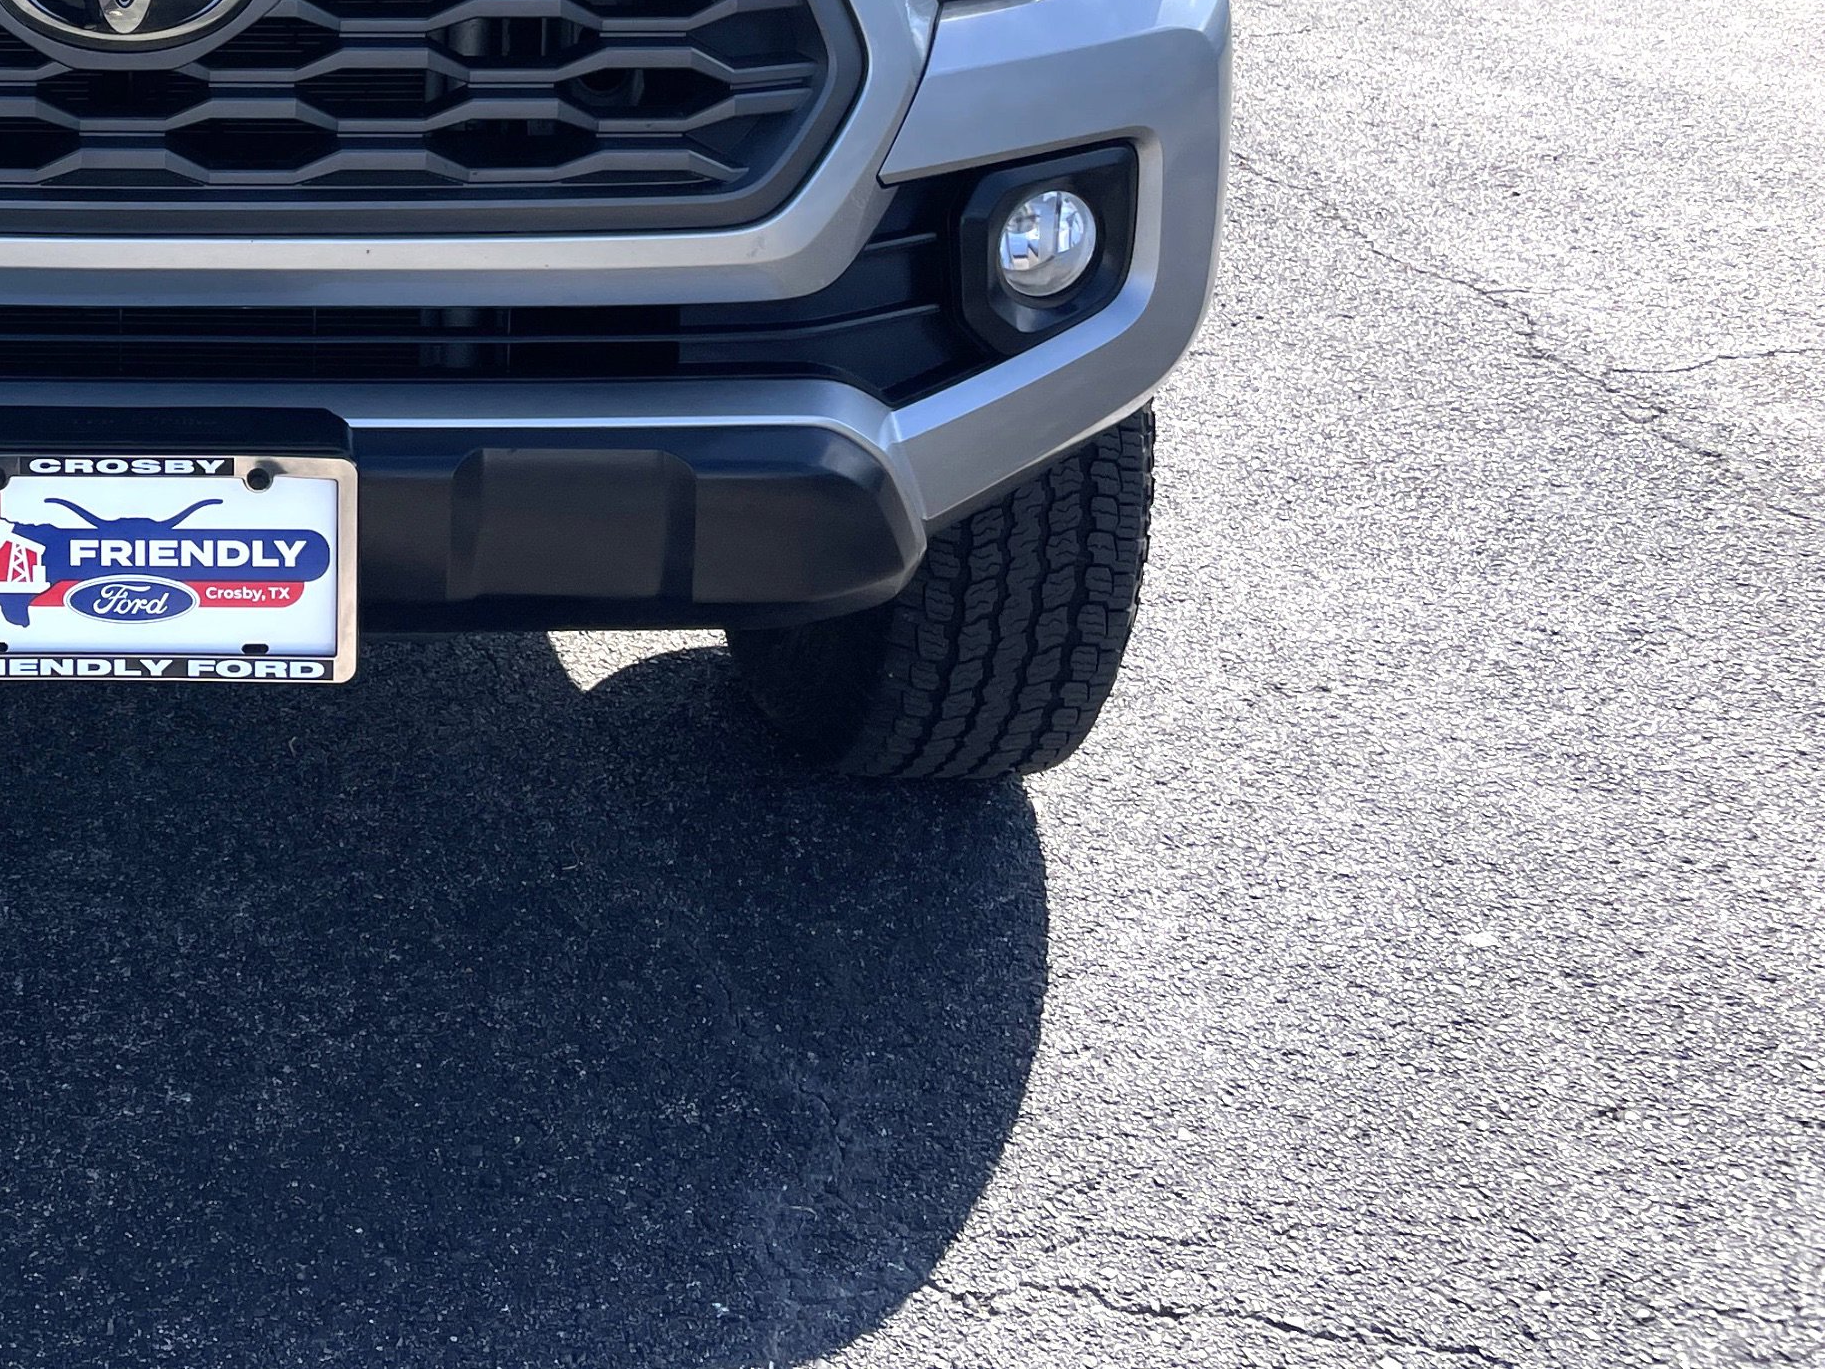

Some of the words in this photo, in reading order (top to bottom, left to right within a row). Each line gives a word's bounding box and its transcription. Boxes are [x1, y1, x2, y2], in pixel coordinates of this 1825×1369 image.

[29, 458, 225, 475] CROSBY
[70, 539, 307, 568] FRIENDLY
[93, 583, 170, 615] Ford
[205, 586, 266, 602] Crosby,
[268, 586, 290, 600] TX
[186, 659, 325, 678] FORD
